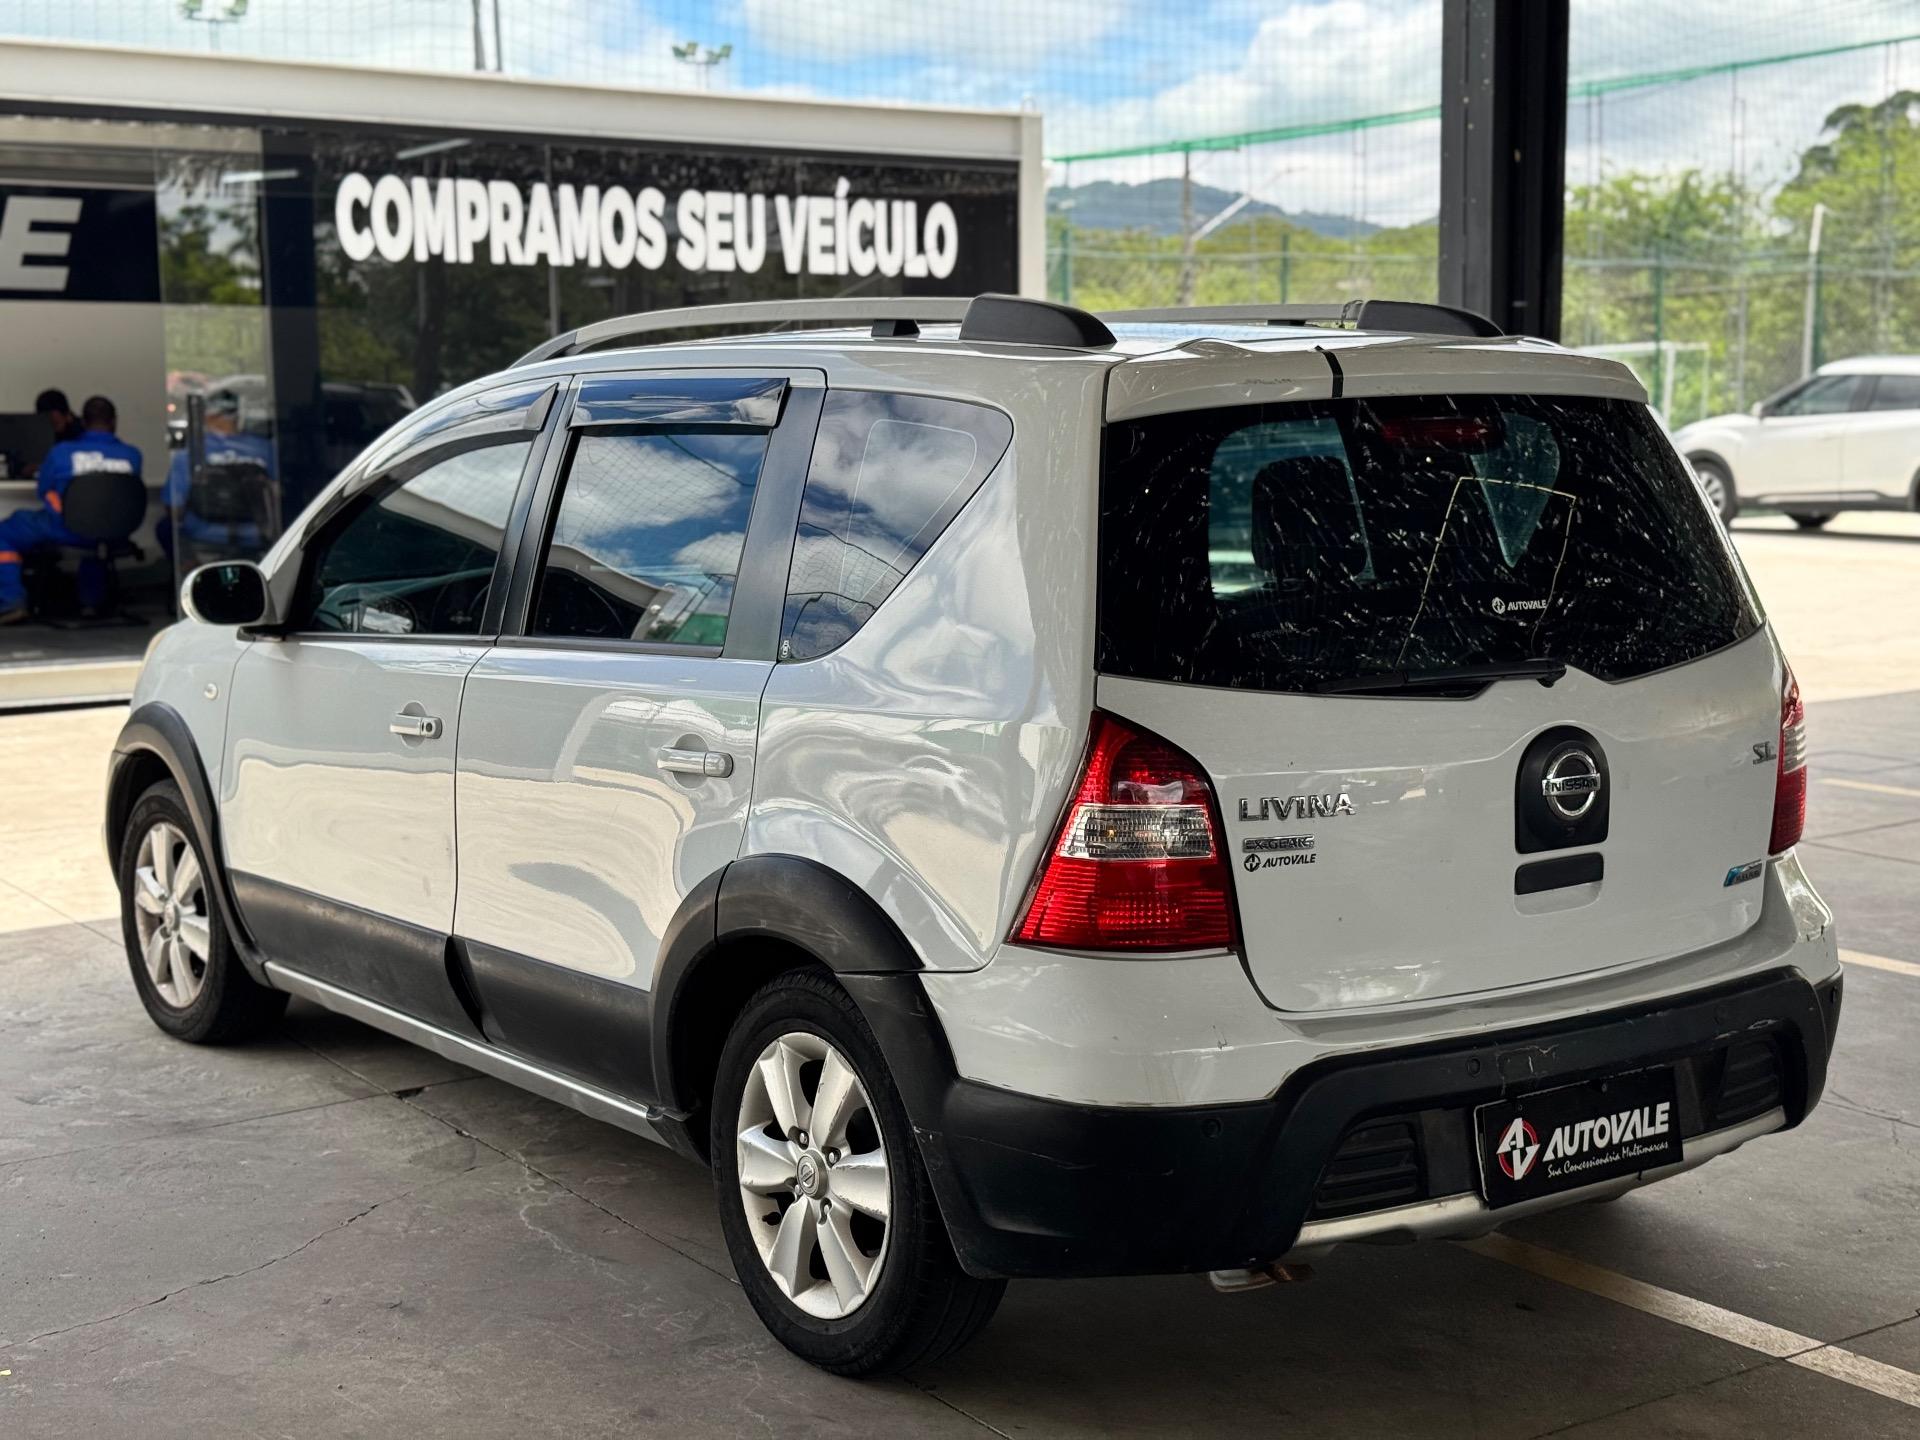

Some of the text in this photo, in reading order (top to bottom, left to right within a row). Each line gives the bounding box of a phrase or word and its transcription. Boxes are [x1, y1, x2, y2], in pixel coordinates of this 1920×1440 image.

[336, 172, 959, 280] COMPRAMOS SEU VEÍCULO
[1507, 599, 1547, 611] AUTOVALE
[1551, 779, 1598, 792] NISSAN
[1239, 793, 1357, 822] LIVINA
[1262, 853, 1317, 869] AUTOVALE
[1542, 1101, 1670, 1162] AUTOVALE
[1547, 1164, 1562, 1178] Sua
[1622, 1141, 1668, 1159] Multimarcas
